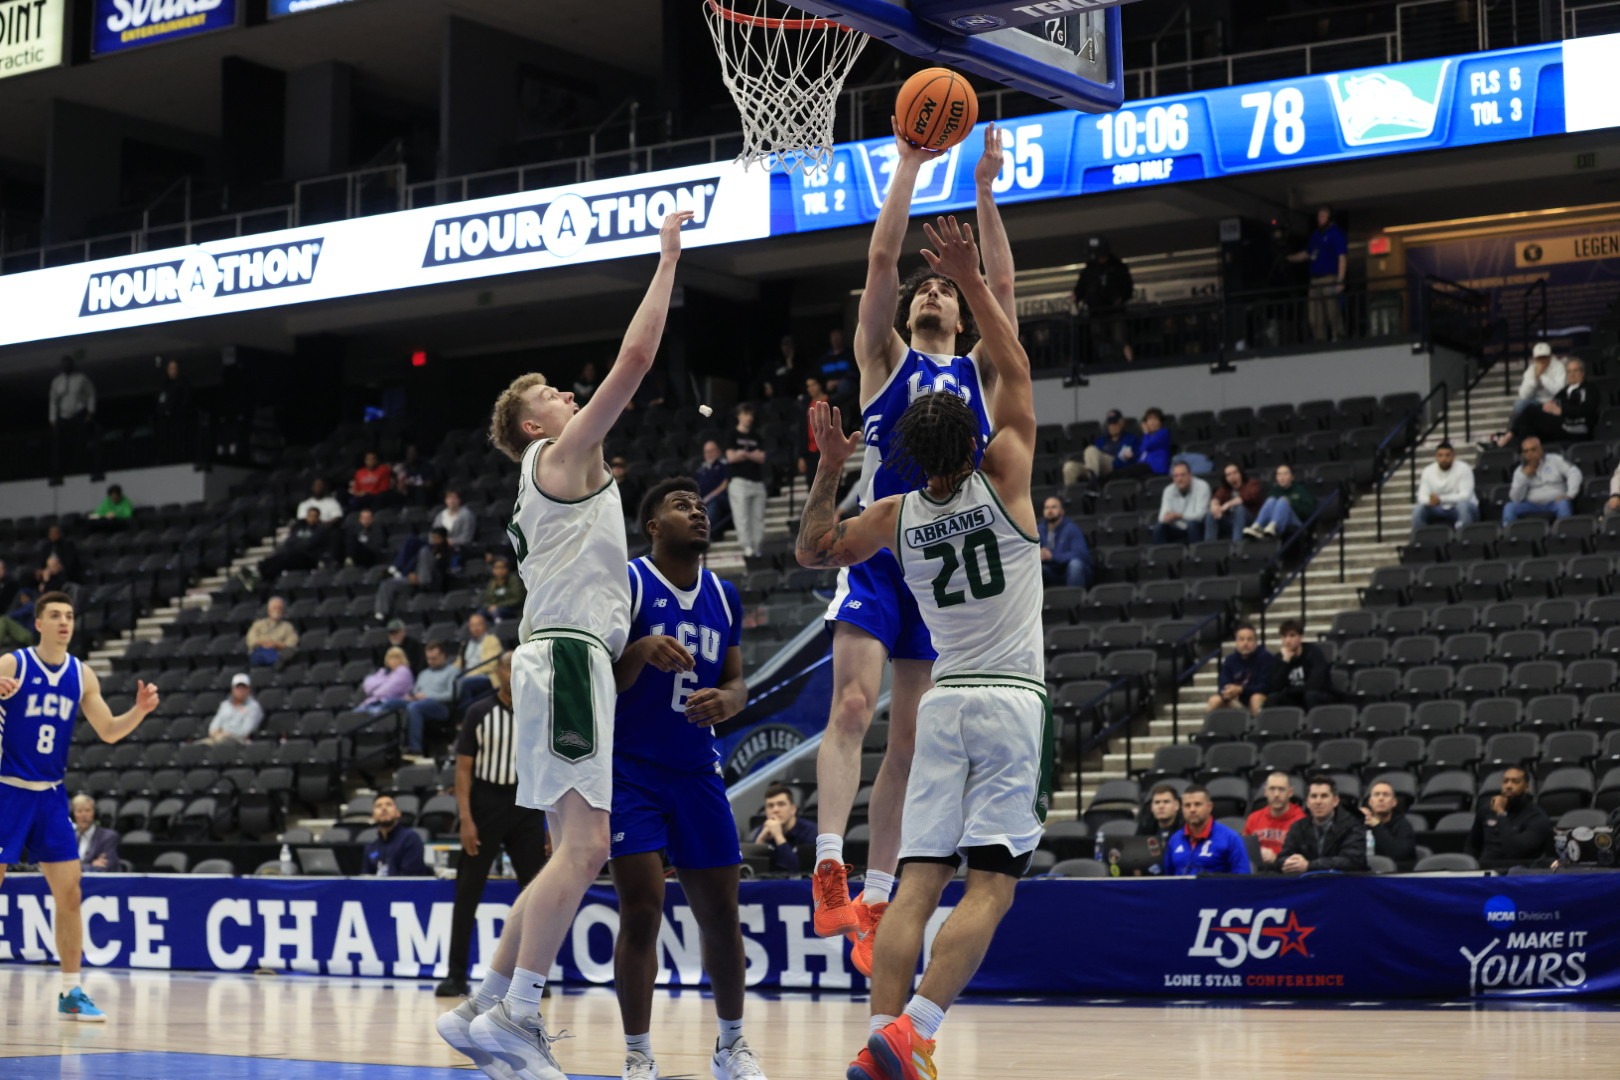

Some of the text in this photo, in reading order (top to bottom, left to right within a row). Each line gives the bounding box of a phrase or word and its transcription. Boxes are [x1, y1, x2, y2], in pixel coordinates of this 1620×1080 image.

[0, 1, 46, 45] INT
[1469, 67, 1521, 97] FLS 5
[914, 97, 937, 135] NCAA
[933, 100, 964, 147] Wilson
[1239, 87, 1306, 160] 78
[1471, 98, 1523, 127] TOL 3
[1096, 103, 1189, 160] 10:06
[834, 161, 846, 184] 4
[993, 123, 1045, 194] 65
[1112, 158, 1173, 185] 2ND HALF
[802, 189, 846, 216] TOL 2
[913, 509, 986, 545] ABRAMS
[924, 528, 1006, 609] 20
[25, 693, 74, 721] LCU
[671, 671, 698, 713] 6
[36, 724, 56, 754] 8
[731, 732, 768, 775] TEXAS
[1487, 911, 1516, 922] NCAA
[1519, 911, 1553, 921] Division
[1187, 908, 1287, 969] LSC
[1506, 931, 1588, 949] MAKE IT
[1164, 974, 1344, 987] LONE STAR CONFERENCE
[1459, 937, 1587, 997] YOURS
